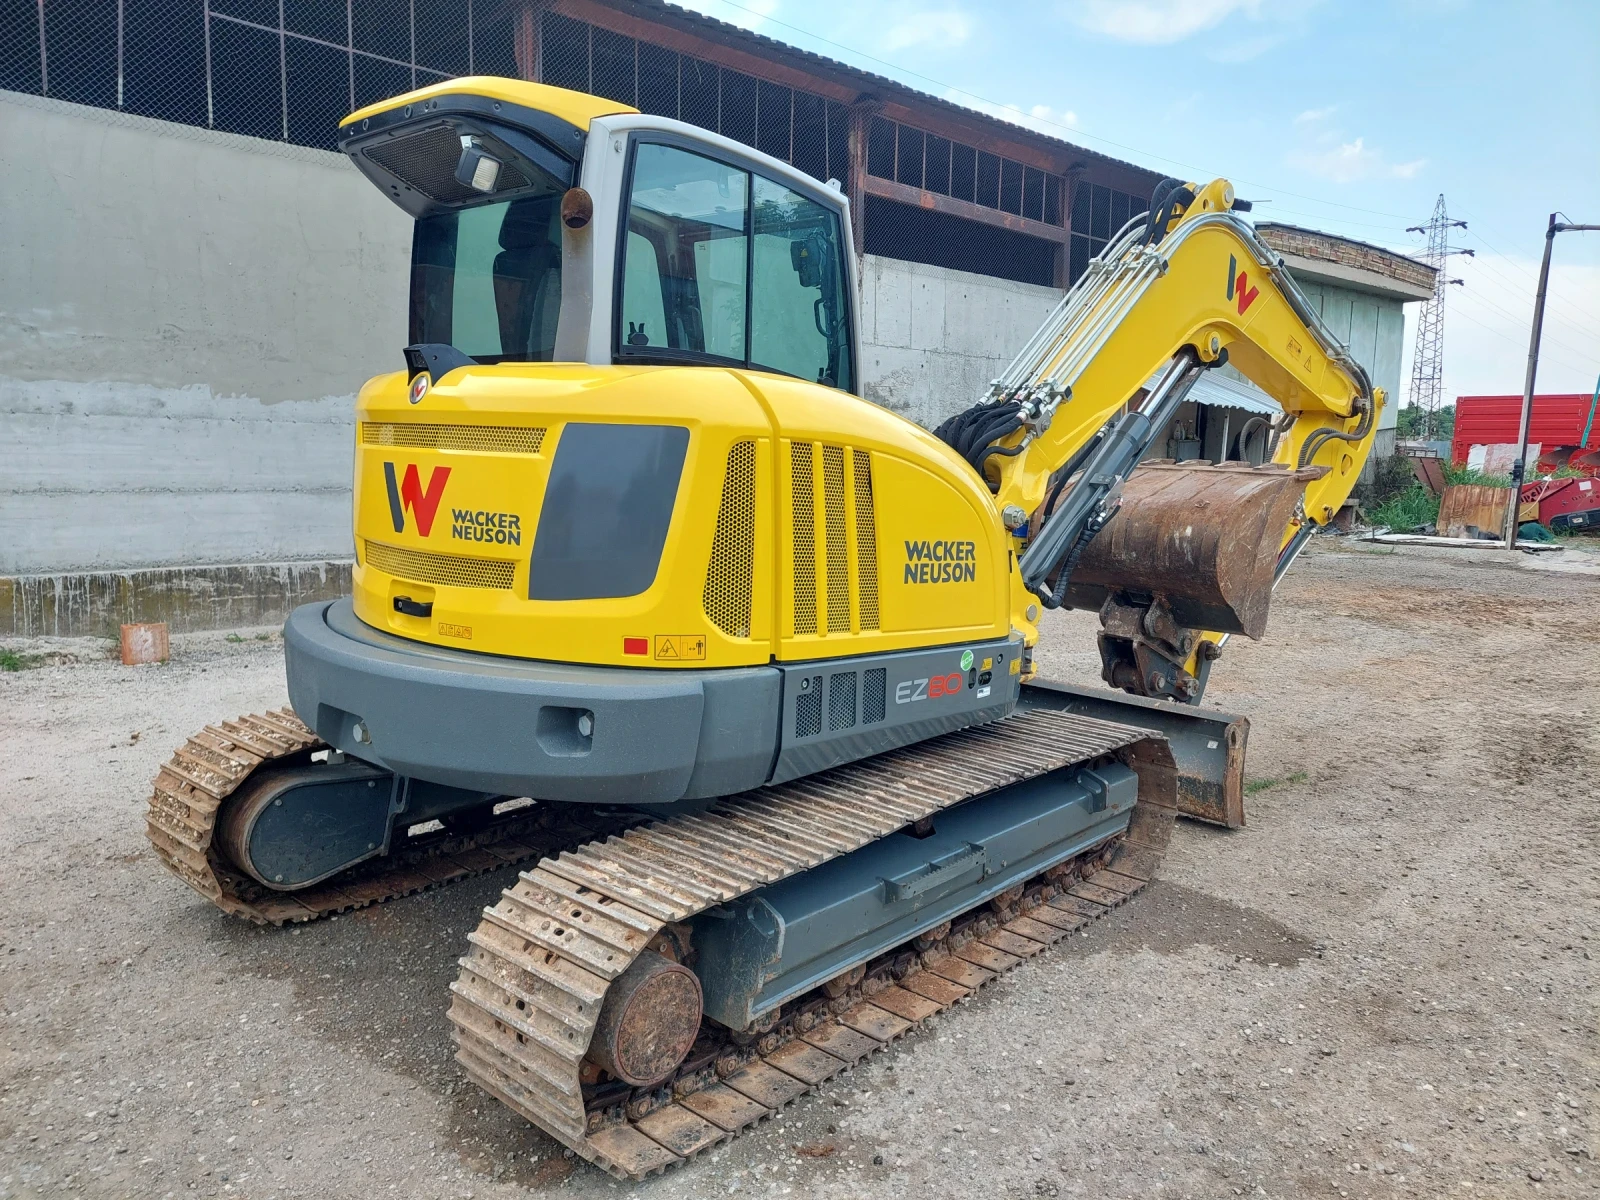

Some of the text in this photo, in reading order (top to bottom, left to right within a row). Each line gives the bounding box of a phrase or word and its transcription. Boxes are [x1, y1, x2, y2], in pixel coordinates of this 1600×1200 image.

[452, 508, 521, 530] WACKER
[452, 524, 521, 546] NEUSON
[904, 540, 976, 562] WACKER
[904, 562, 976, 585] NEUSON
[895, 672, 963, 705] EZ80
